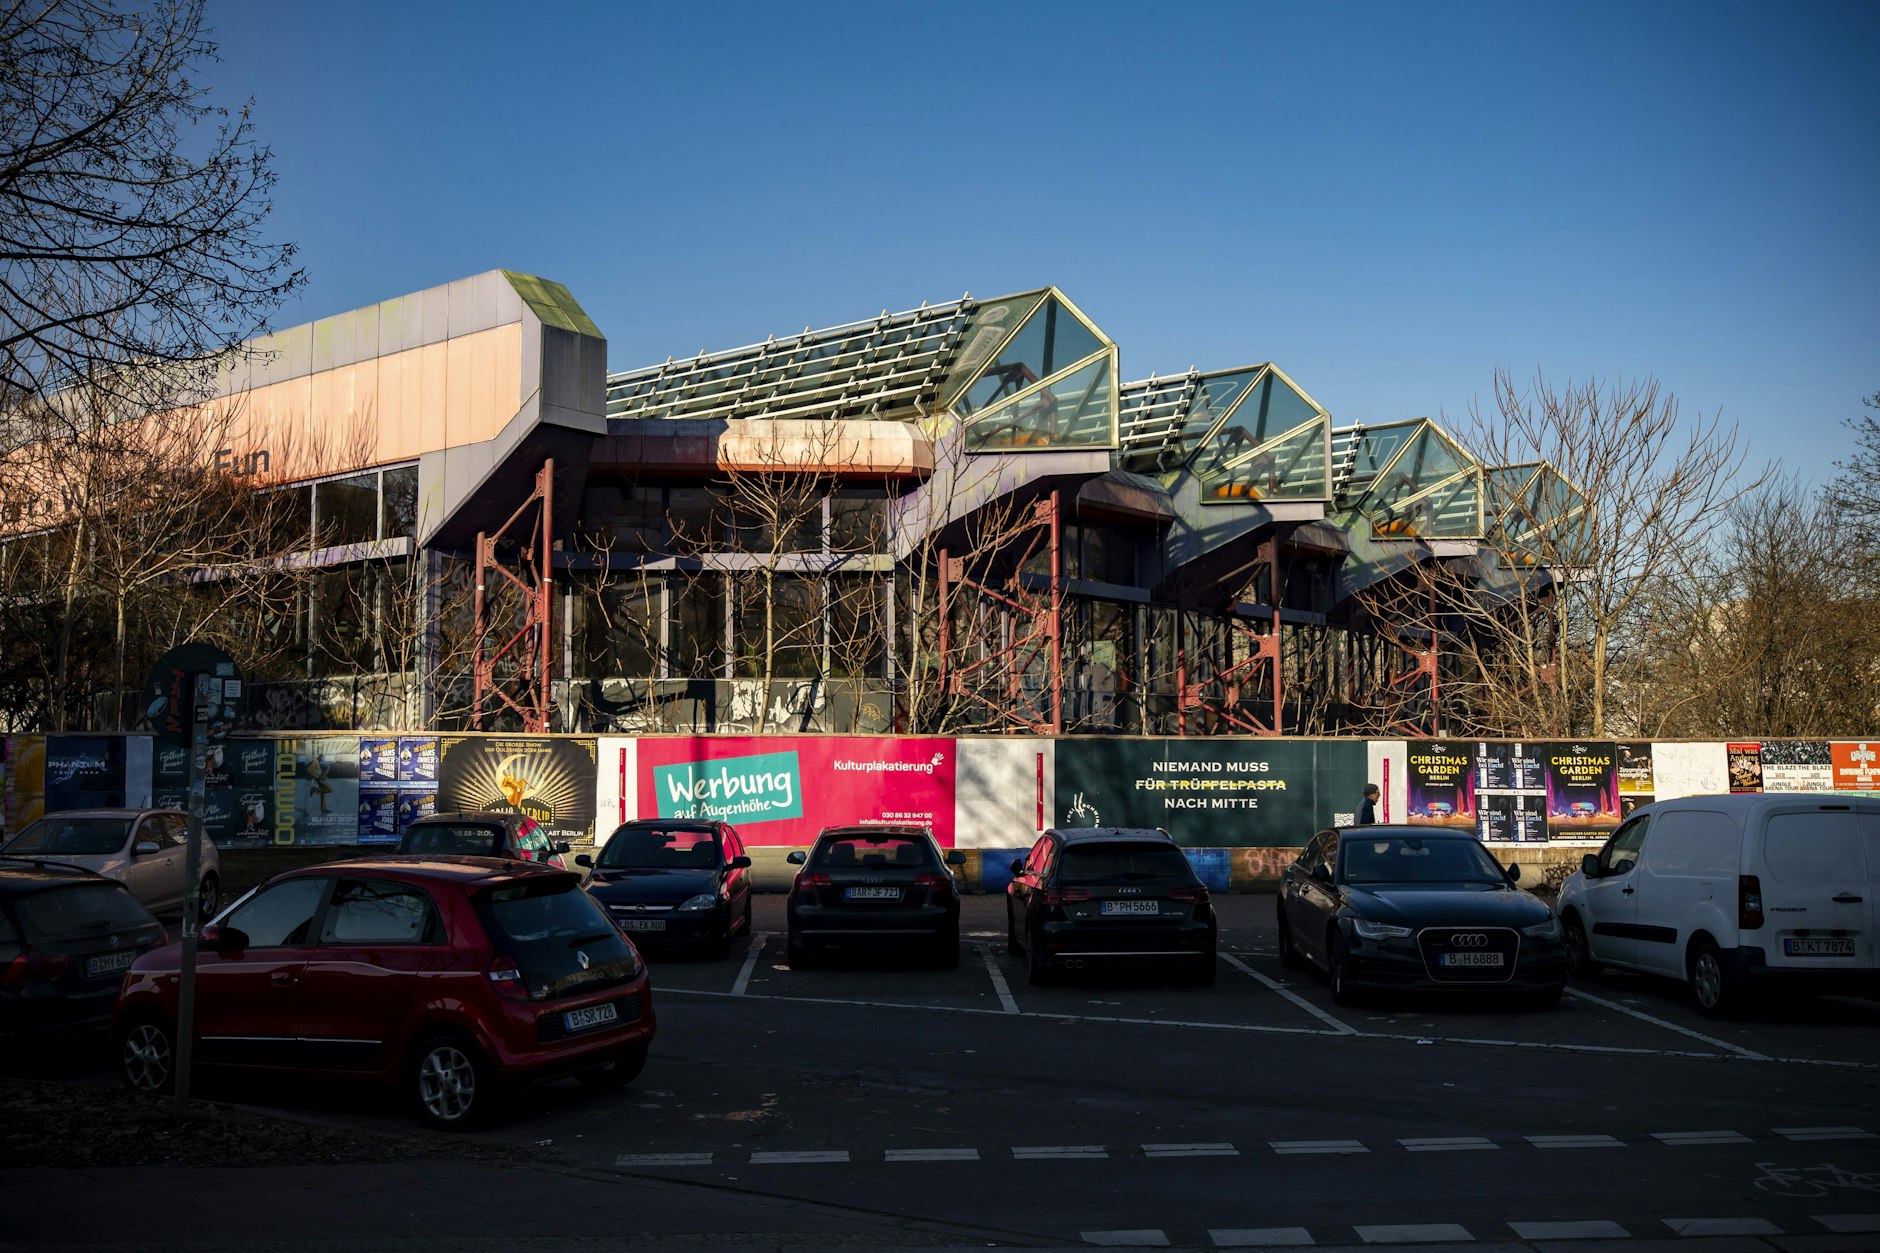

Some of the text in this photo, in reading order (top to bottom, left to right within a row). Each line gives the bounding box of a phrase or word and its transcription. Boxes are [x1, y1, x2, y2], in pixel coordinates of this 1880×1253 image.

[1410, 755, 1467, 765] CHRISTMAS
[1551, 756, 1610, 765] CHRISTMAS
[834, 760, 933, 774] Kulturplakatierung
[1152, 761, 1270, 772] NIEMAND MUSS
[1418, 765, 1459, 774] GARDEN
[1560, 766, 1602, 775] GARDEN
[668, 765, 793, 807] Werbung
[1135, 778, 1287, 790] FÜR TRÜFFELPASTA
[1164, 798, 1258, 809] NACH MITTE
[699, 798, 772, 822] Augenhöhe
